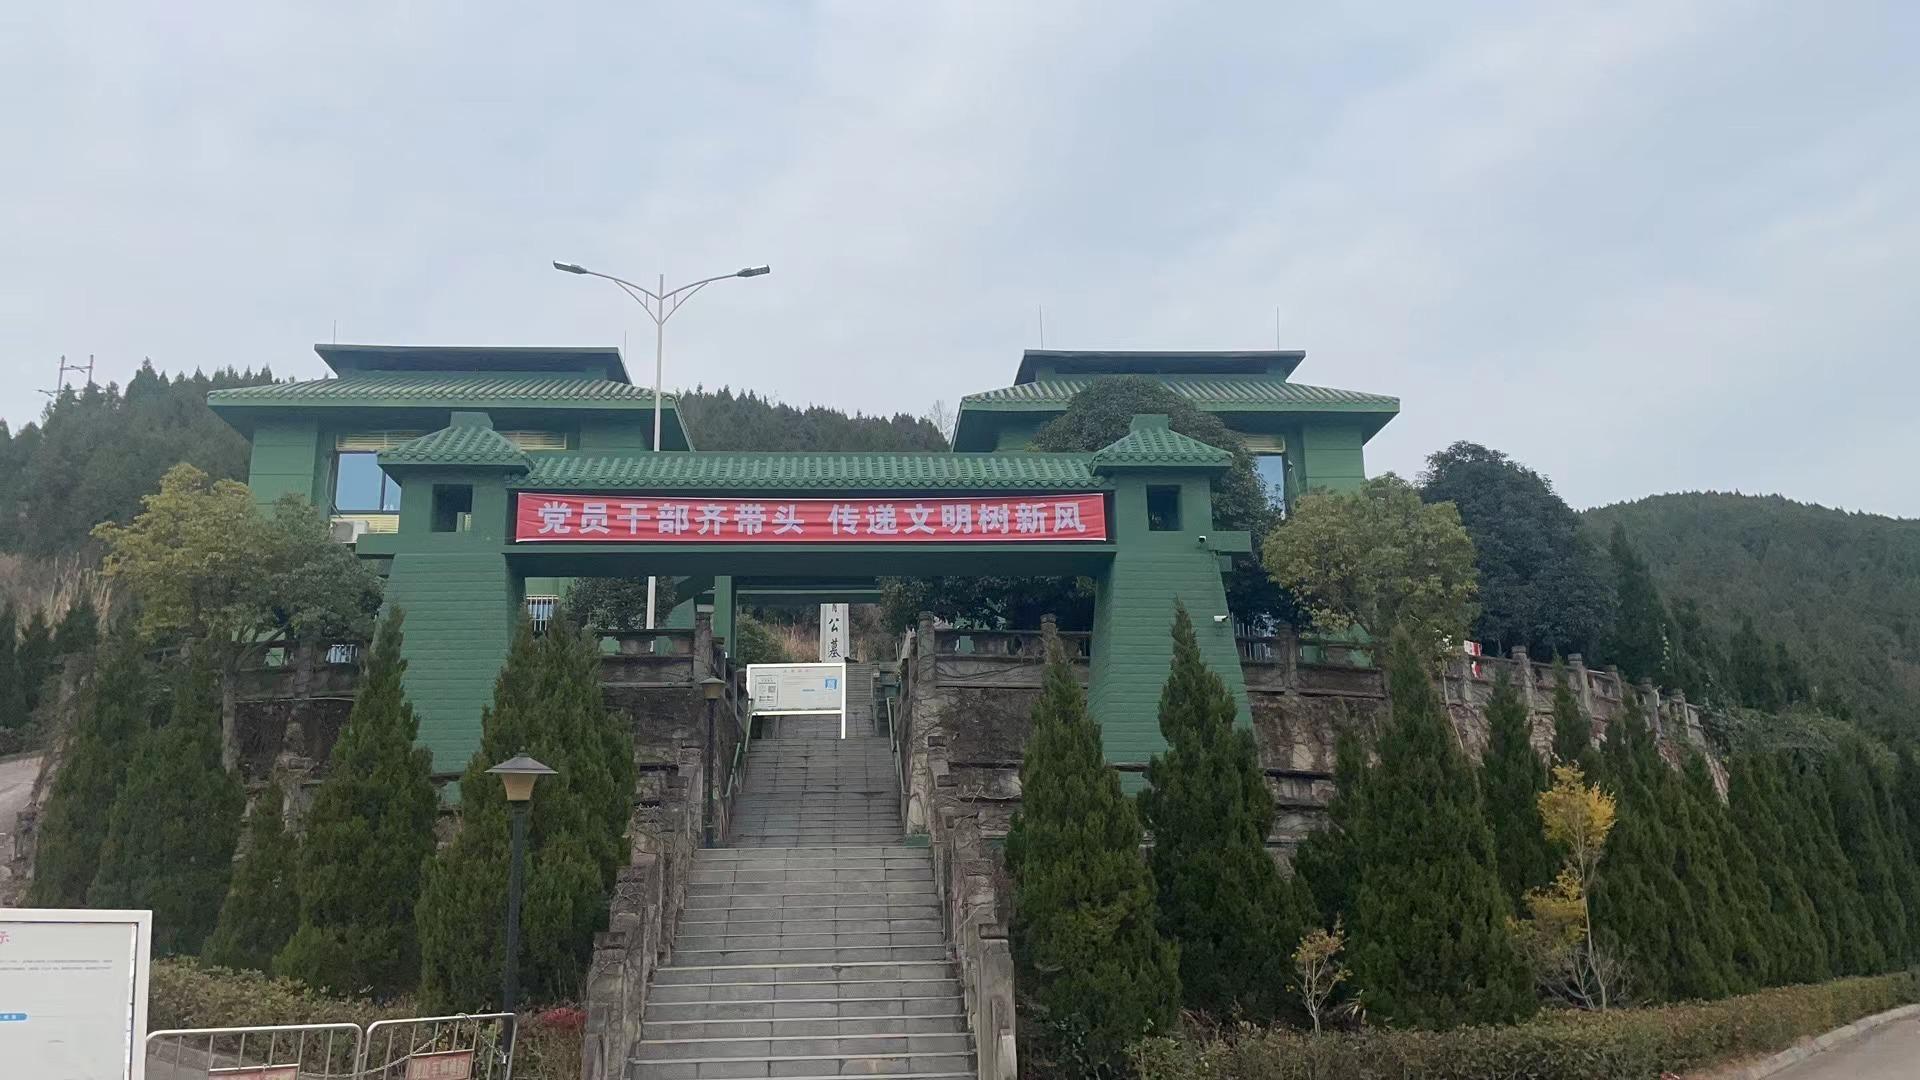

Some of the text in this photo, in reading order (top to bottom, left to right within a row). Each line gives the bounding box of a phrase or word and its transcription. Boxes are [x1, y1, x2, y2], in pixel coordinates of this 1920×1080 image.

[538, 501, 1086, 535] 党员干部齐带头 传递文明树新风
